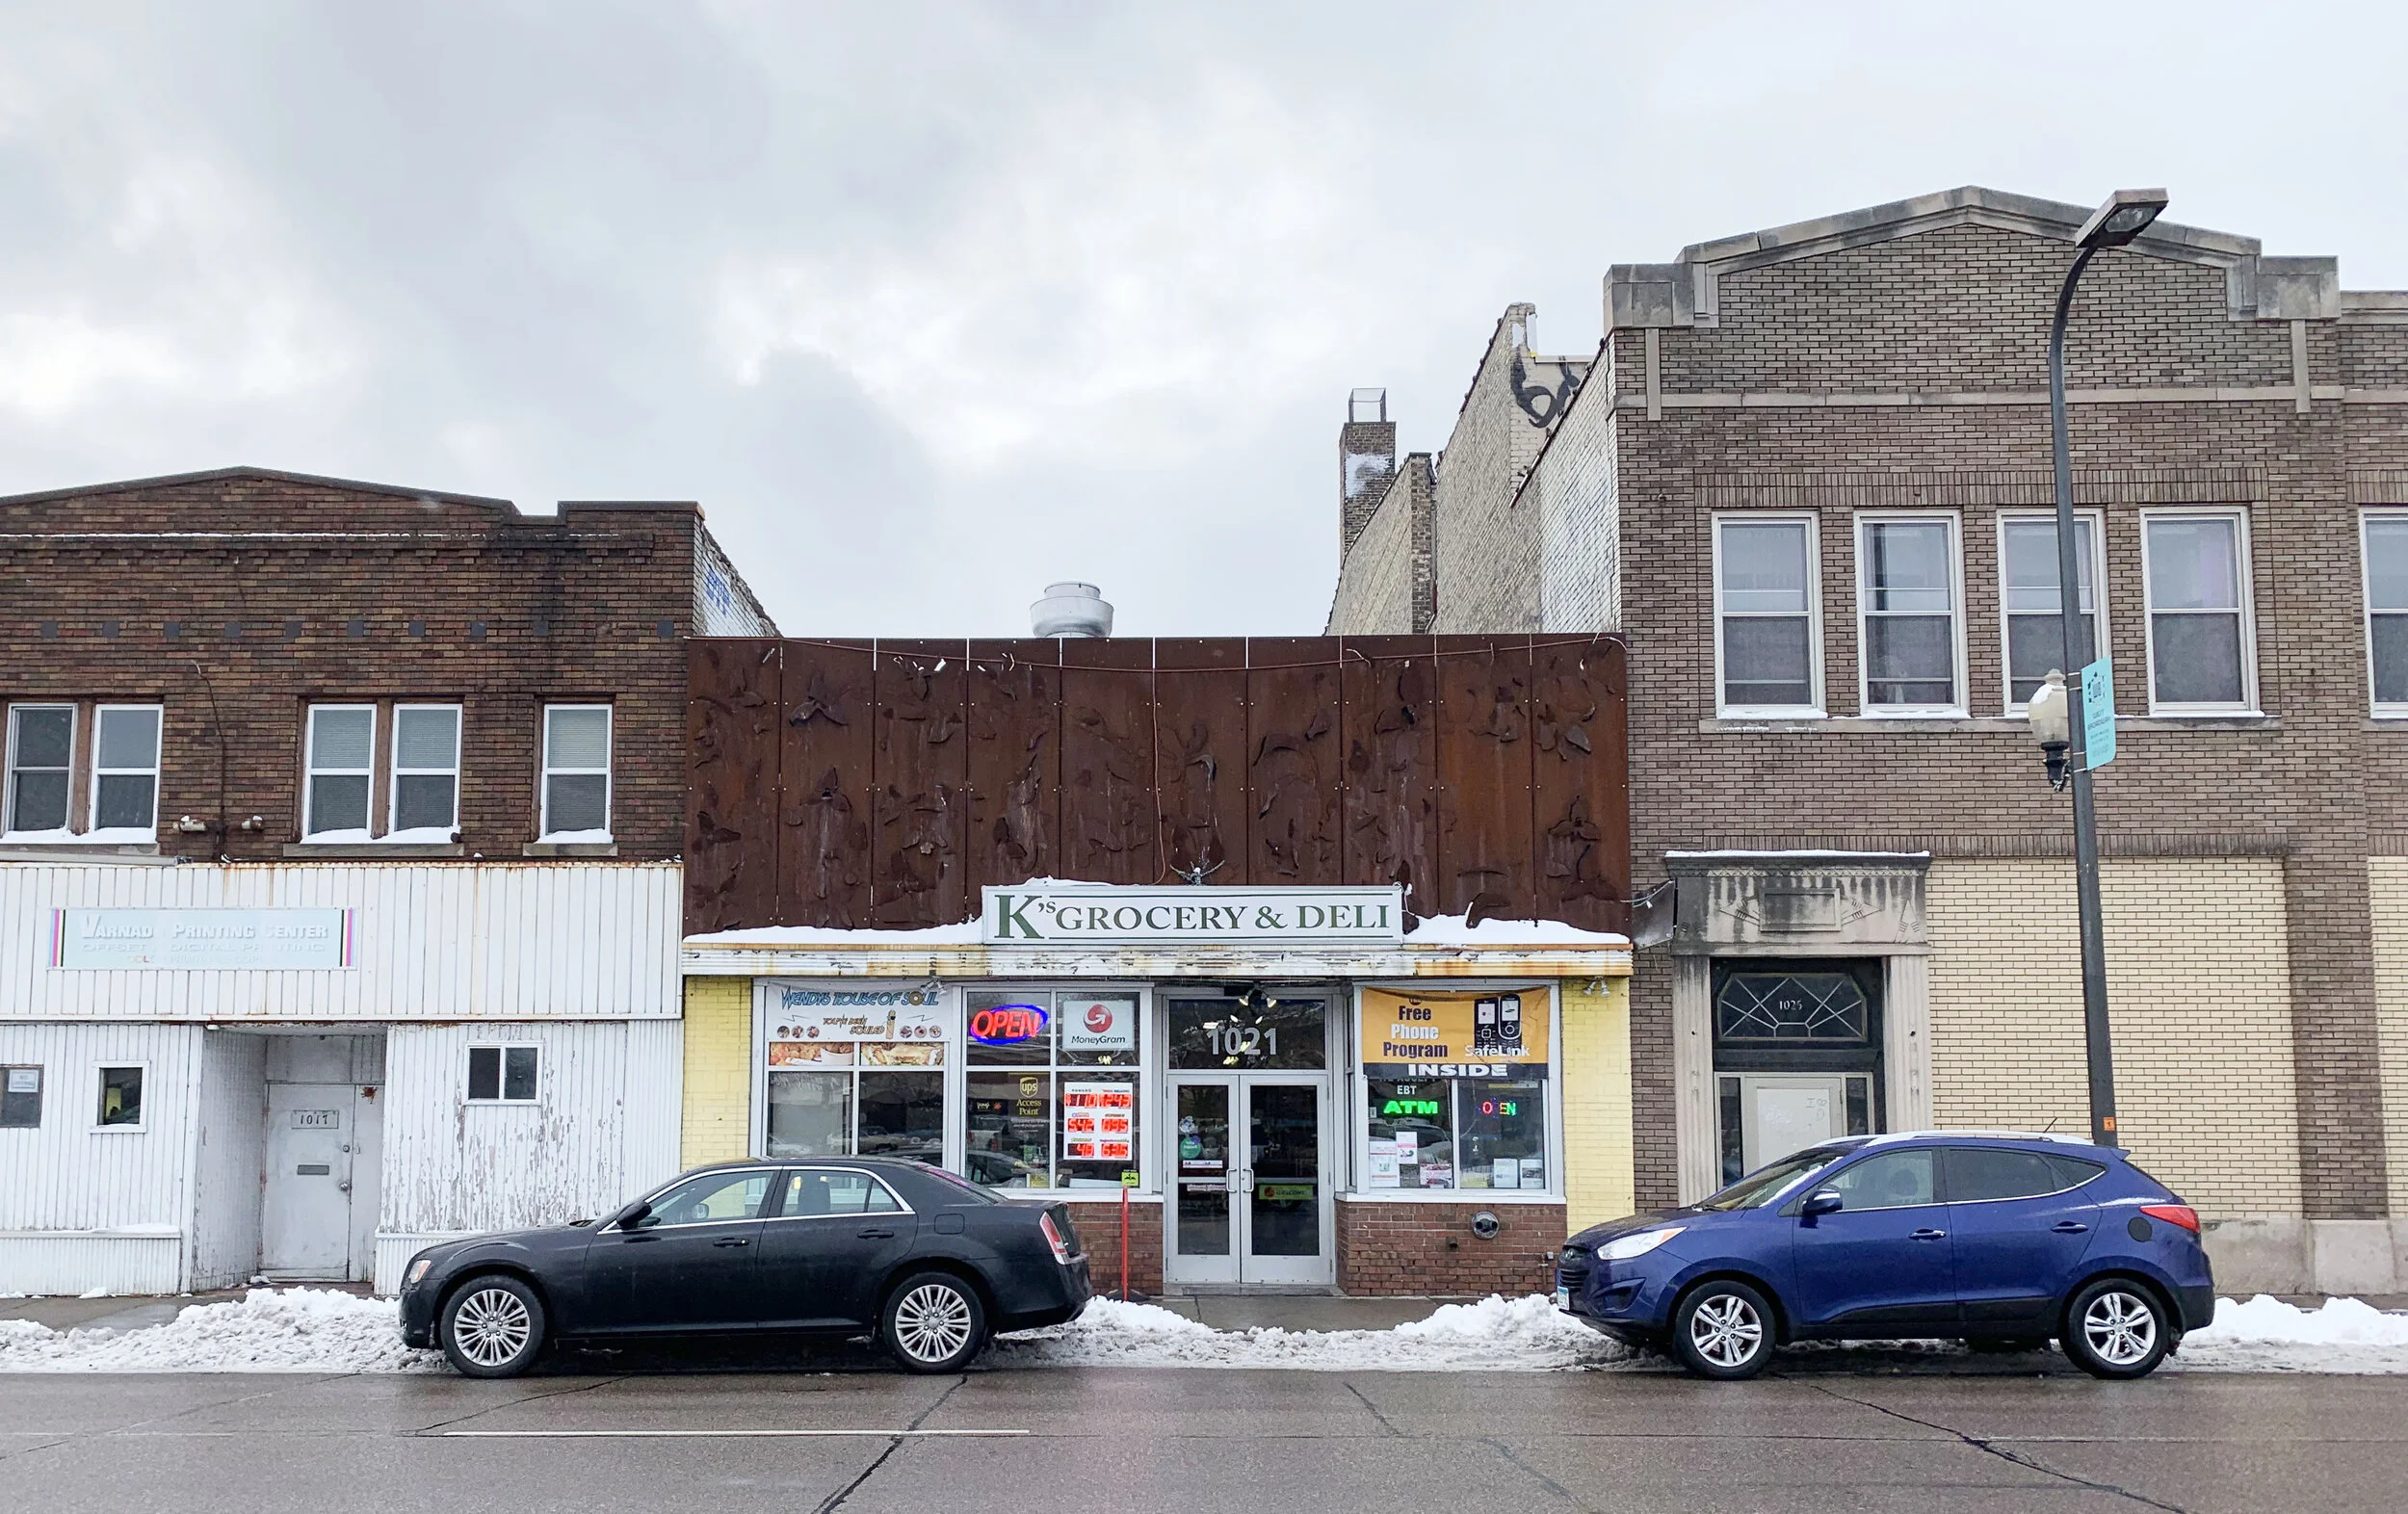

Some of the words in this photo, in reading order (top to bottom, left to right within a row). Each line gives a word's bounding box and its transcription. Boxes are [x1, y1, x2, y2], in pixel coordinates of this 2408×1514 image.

[1058, 905, 1248, 930] GROCERY
[1254, 905, 1288, 929] &
[1296, 904, 1390, 929] DELI
[170, 921, 256, 940] PRINTING
[241, 942, 326, 953] PRTING
[832, 992, 880, 1006] HOUSE
[877, 991, 903, 1006] OF
[901, 990, 939, 1006] SOUL
[1398, 1005, 1432, 1021] Free
[973, 1009, 1040, 1038] OPEN
[1390, 1024, 1439, 1040] Phone
[1071, 1035, 1126, 1046] MoneyGram
[1206, 1027, 1277, 1056] 1021
[1383, 1041, 1449, 1059] Program
[1408, 1063, 1508, 1077] INSIDE
[1021, 1082, 1037, 1095] ups
[1397, 1084, 1417, 1095] EBT
[1016, 1098, 1042, 1108] Access
[1383, 1100, 1439, 1114] ATM
[1481, 1100, 1517, 1115] OEN
[1019, 1107, 1039, 1116] Point
[301, 1114, 328, 1125] 1017
